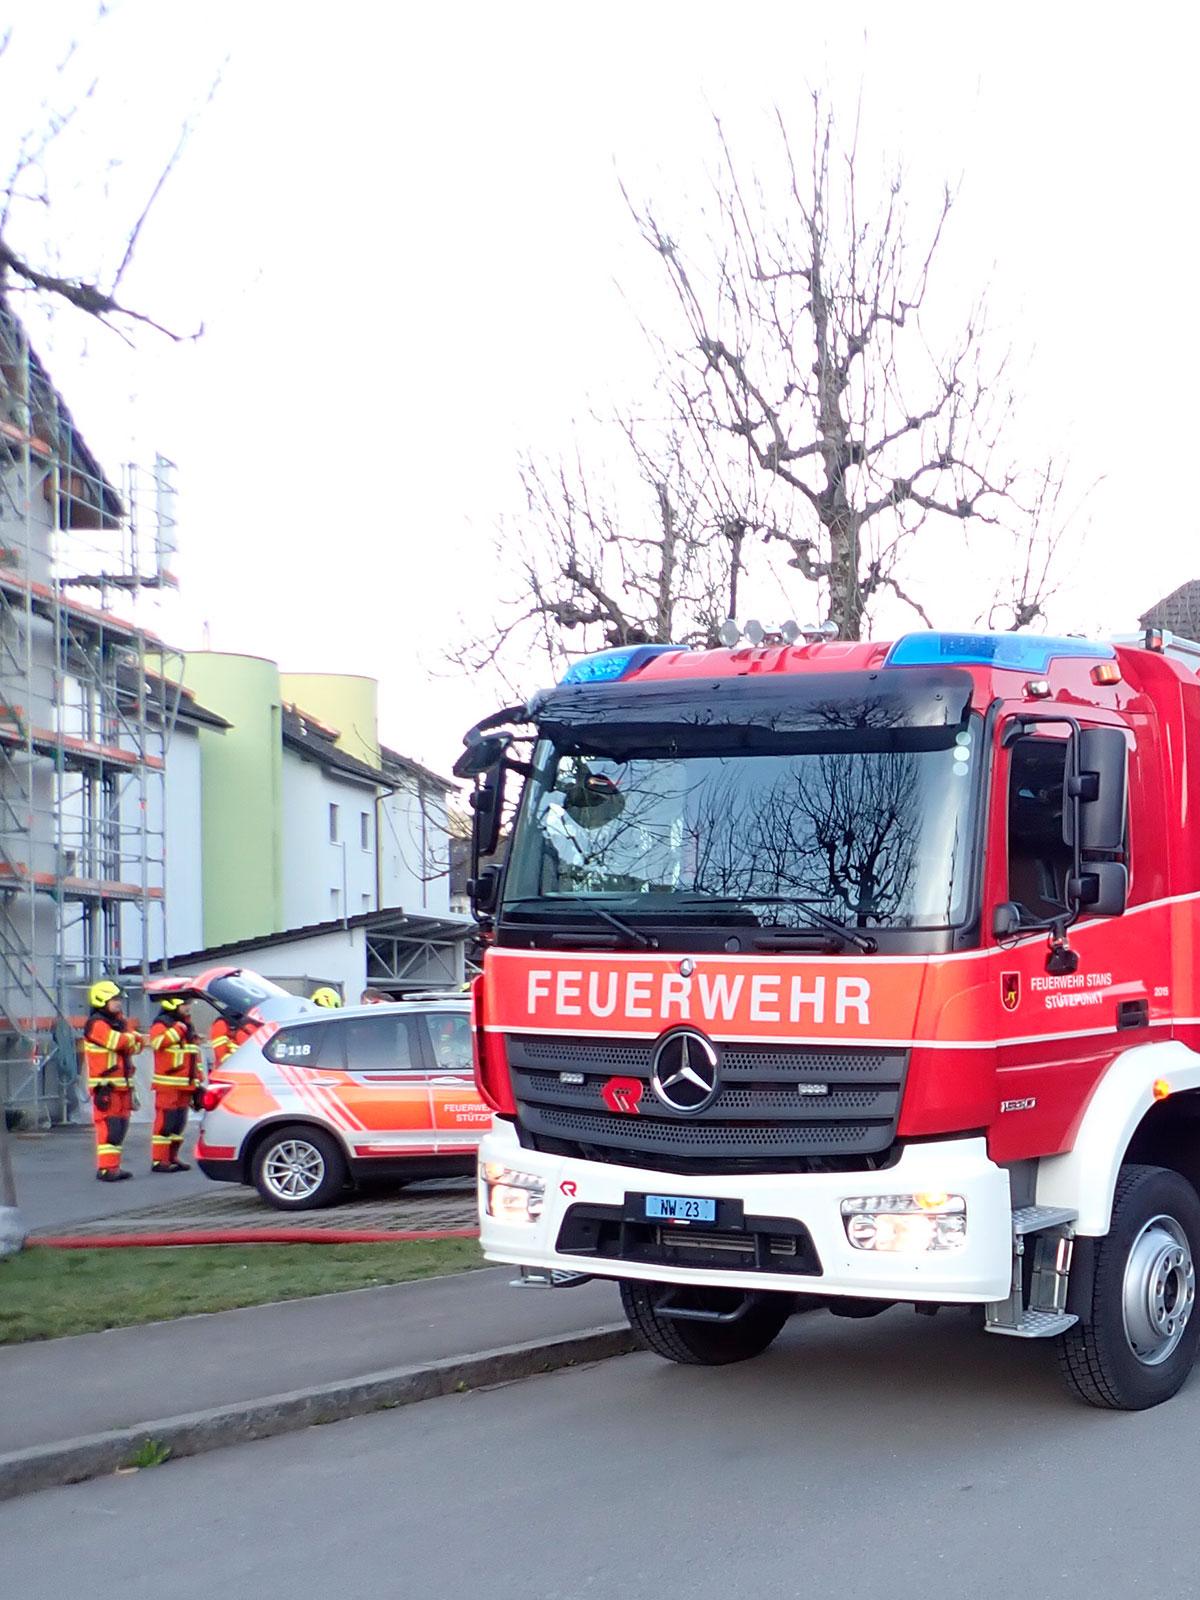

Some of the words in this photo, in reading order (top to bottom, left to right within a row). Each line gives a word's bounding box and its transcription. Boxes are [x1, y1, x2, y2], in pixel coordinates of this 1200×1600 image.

[1031, 974, 1085, 991] FEUERWEHR
[1086, 973, 1112, 987] STANS
[527, 970, 871, 1025] FEUERWEHR
[1045, 991, 1104, 1009] STÜTZPUNKT
[288, 1044, 311, 1056] 118
[444, 1103, 491, 1112] FEUERWE
[685, 1201, 700, 1218] 23
